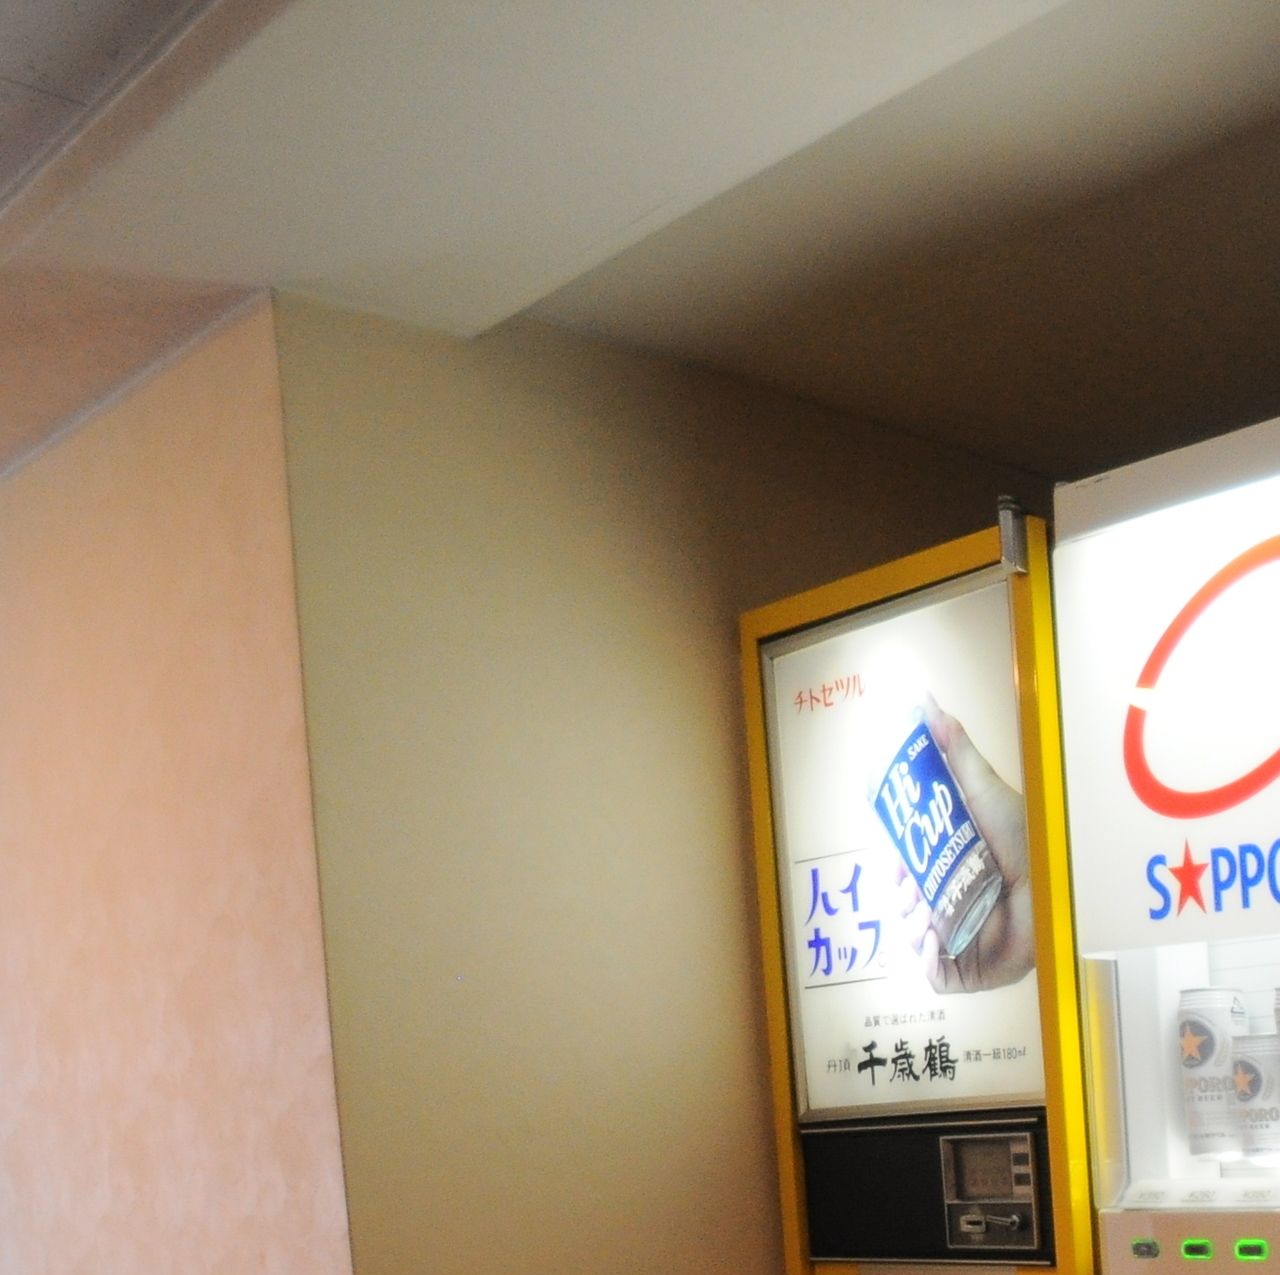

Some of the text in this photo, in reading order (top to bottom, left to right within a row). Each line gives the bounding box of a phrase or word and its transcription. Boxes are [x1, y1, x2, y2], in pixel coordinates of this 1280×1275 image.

[793, 672, 866, 713] チトセツル
[908, 734, 929, 760] SAKE
[881, 761, 920, 840] Hi
[904, 781, 953, 873] Cup
[803, 863, 862, 926] ハイ
[857, 1035, 959, 1087] 千歳鶴
